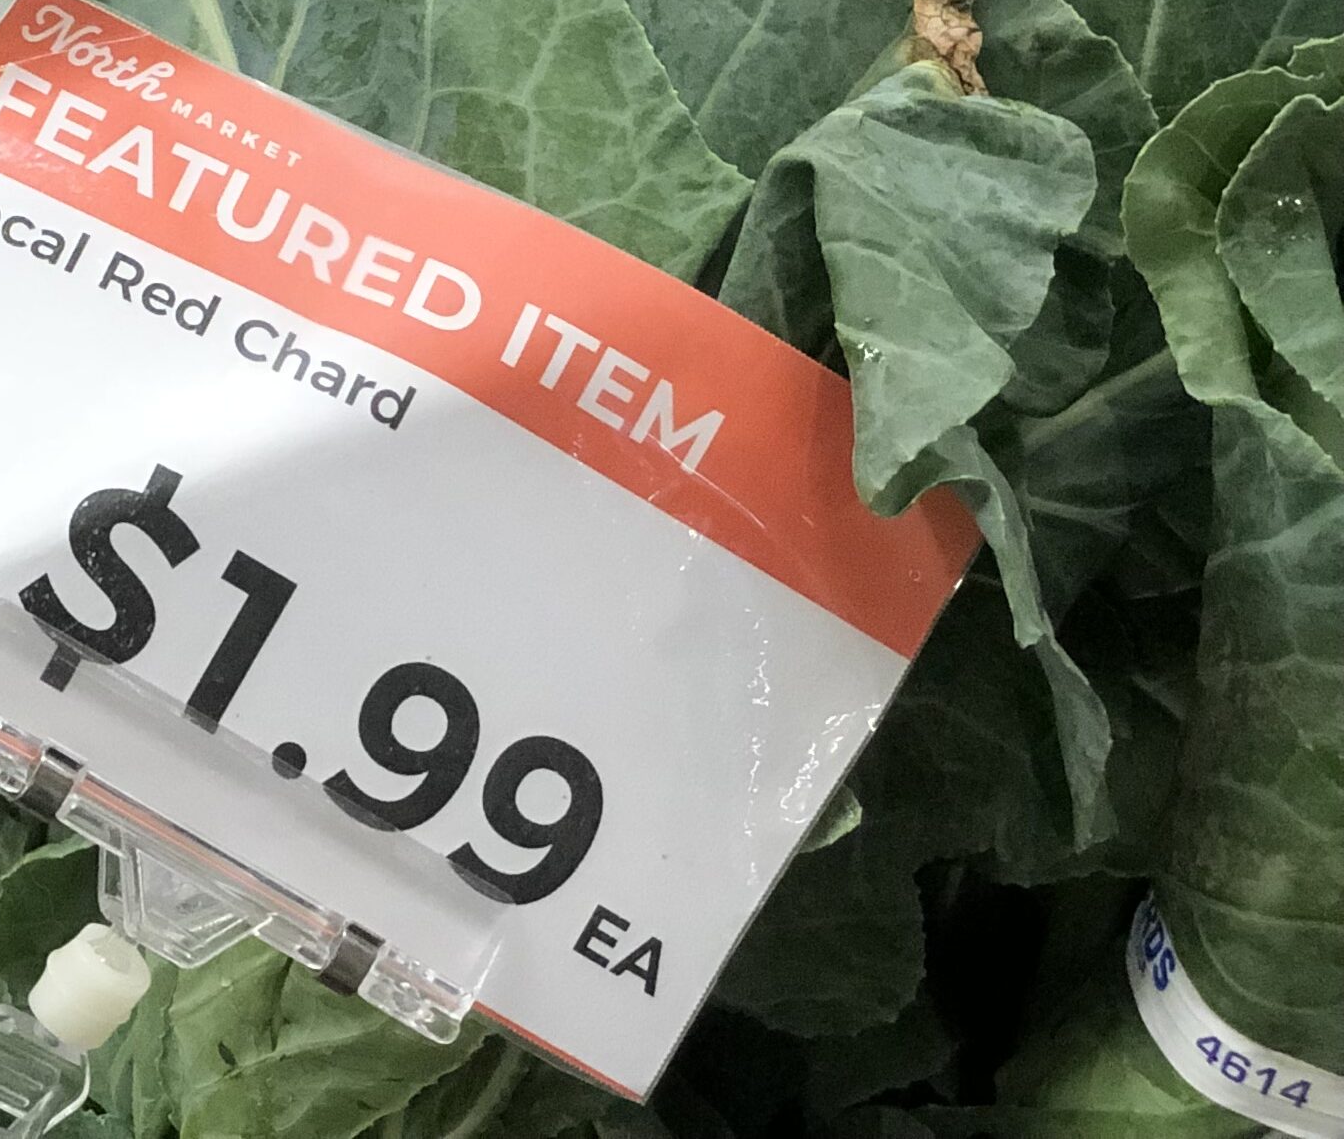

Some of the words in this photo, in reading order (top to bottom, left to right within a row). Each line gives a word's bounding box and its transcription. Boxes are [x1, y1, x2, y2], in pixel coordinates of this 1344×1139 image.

[22, 5, 176, 102] North
[170, 97, 303, 168] MARKET
[99, 251, 222, 337] Red
[234, 317, 419, 432] Chard
[499, 302, 726, 475] ITEM
[17, 464, 605, 906] $1.99
[572, 904, 664, 997] EA
[1196, 1035, 1312, 1109] 4614
